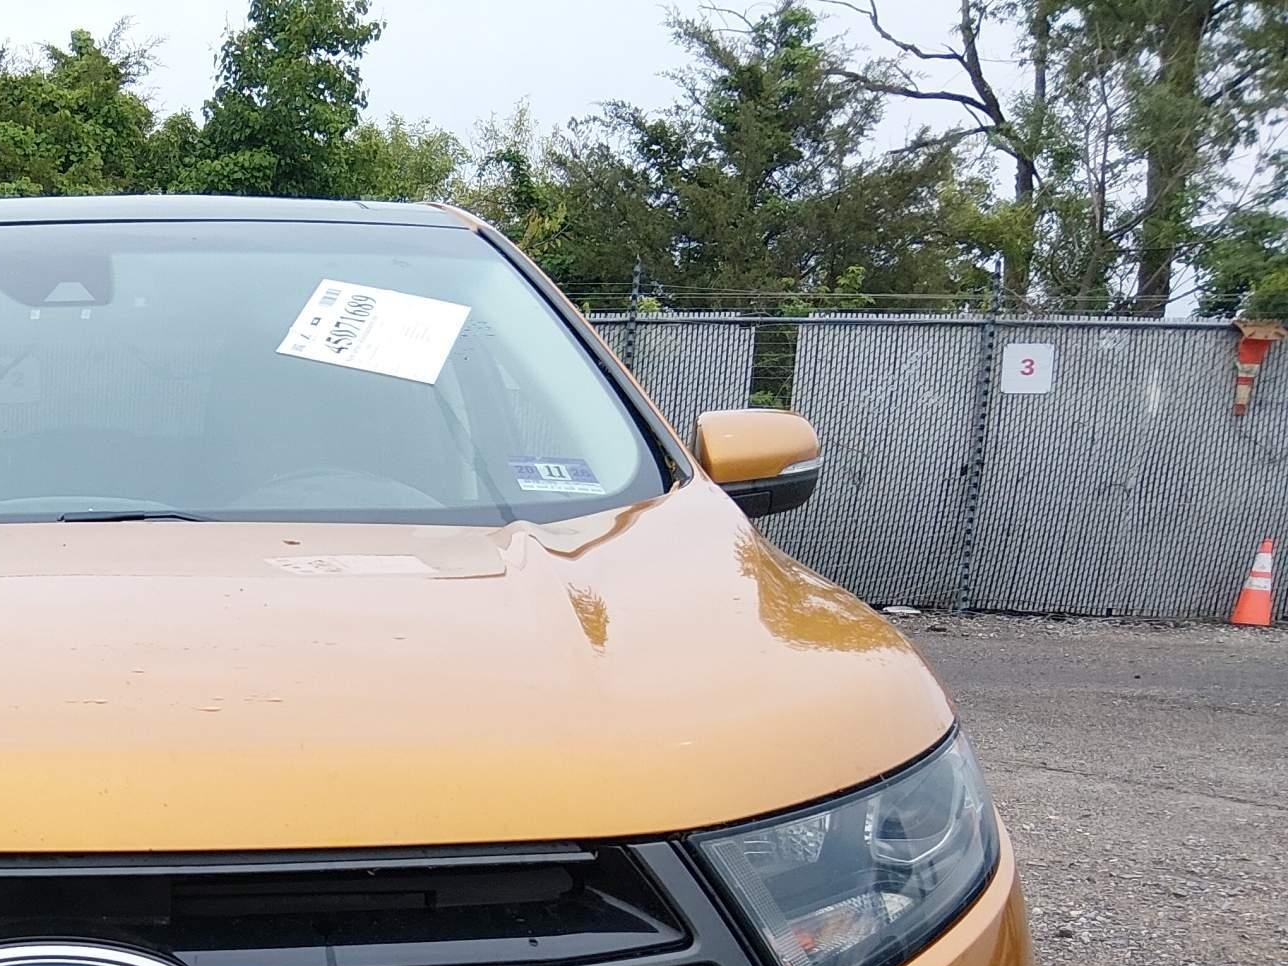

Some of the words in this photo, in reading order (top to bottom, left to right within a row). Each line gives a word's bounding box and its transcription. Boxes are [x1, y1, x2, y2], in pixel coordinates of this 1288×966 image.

[324, 294, 377, 355] 45071689
[1020, 358, 1035, 376] 3
[544, 464, 566, 478] 11
